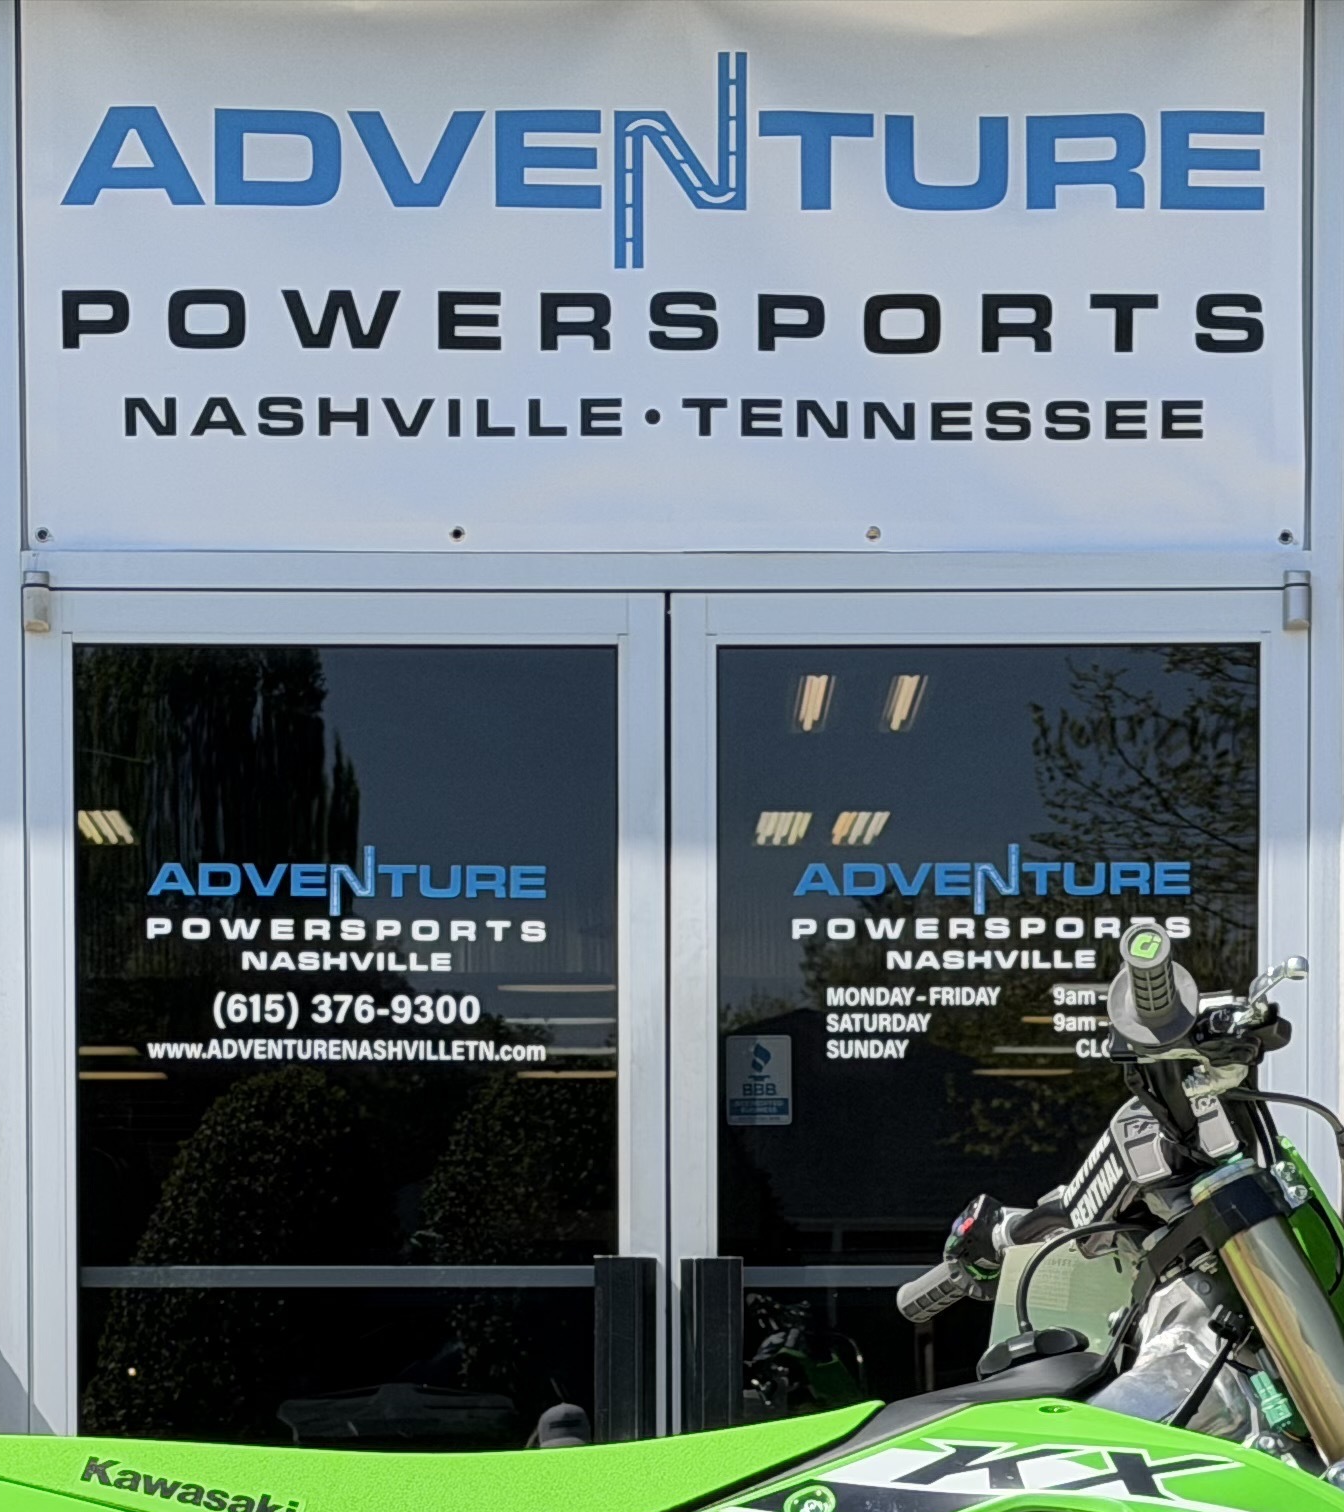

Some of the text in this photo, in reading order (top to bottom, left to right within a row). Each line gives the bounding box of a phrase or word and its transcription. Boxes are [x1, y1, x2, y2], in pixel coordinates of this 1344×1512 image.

[61, 51, 1267, 272] ADVENTURE
[61, 289, 1267, 357] POWERSPORTS
[123, 396, 1205, 442] NASHVILLE TENNESSEE
[147, 845, 548, 917] ADVENTURE
[792, 843, 1193, 915] ADVENTURE
[146, 918, 548, 943] POWERSPORTS
[241, 951, 453, 972] NASHVILLE
[886, 950, 1097, 970] NASHVILLE
[212, 991, 482, 1029] (615) 376-9300
[826, 1013, 933, 1033] SATURDAY
[147, 1039, 548, 1062] www.ADVENTURENASHVILLETN.com
[826, 1040, 911, 1060] SUNDAY
[742, 1082, 777, 1097] BBB
[1069, 1151, 1124, 1230] RENTHAL
[896, 1442, 1238, 1497] KX
